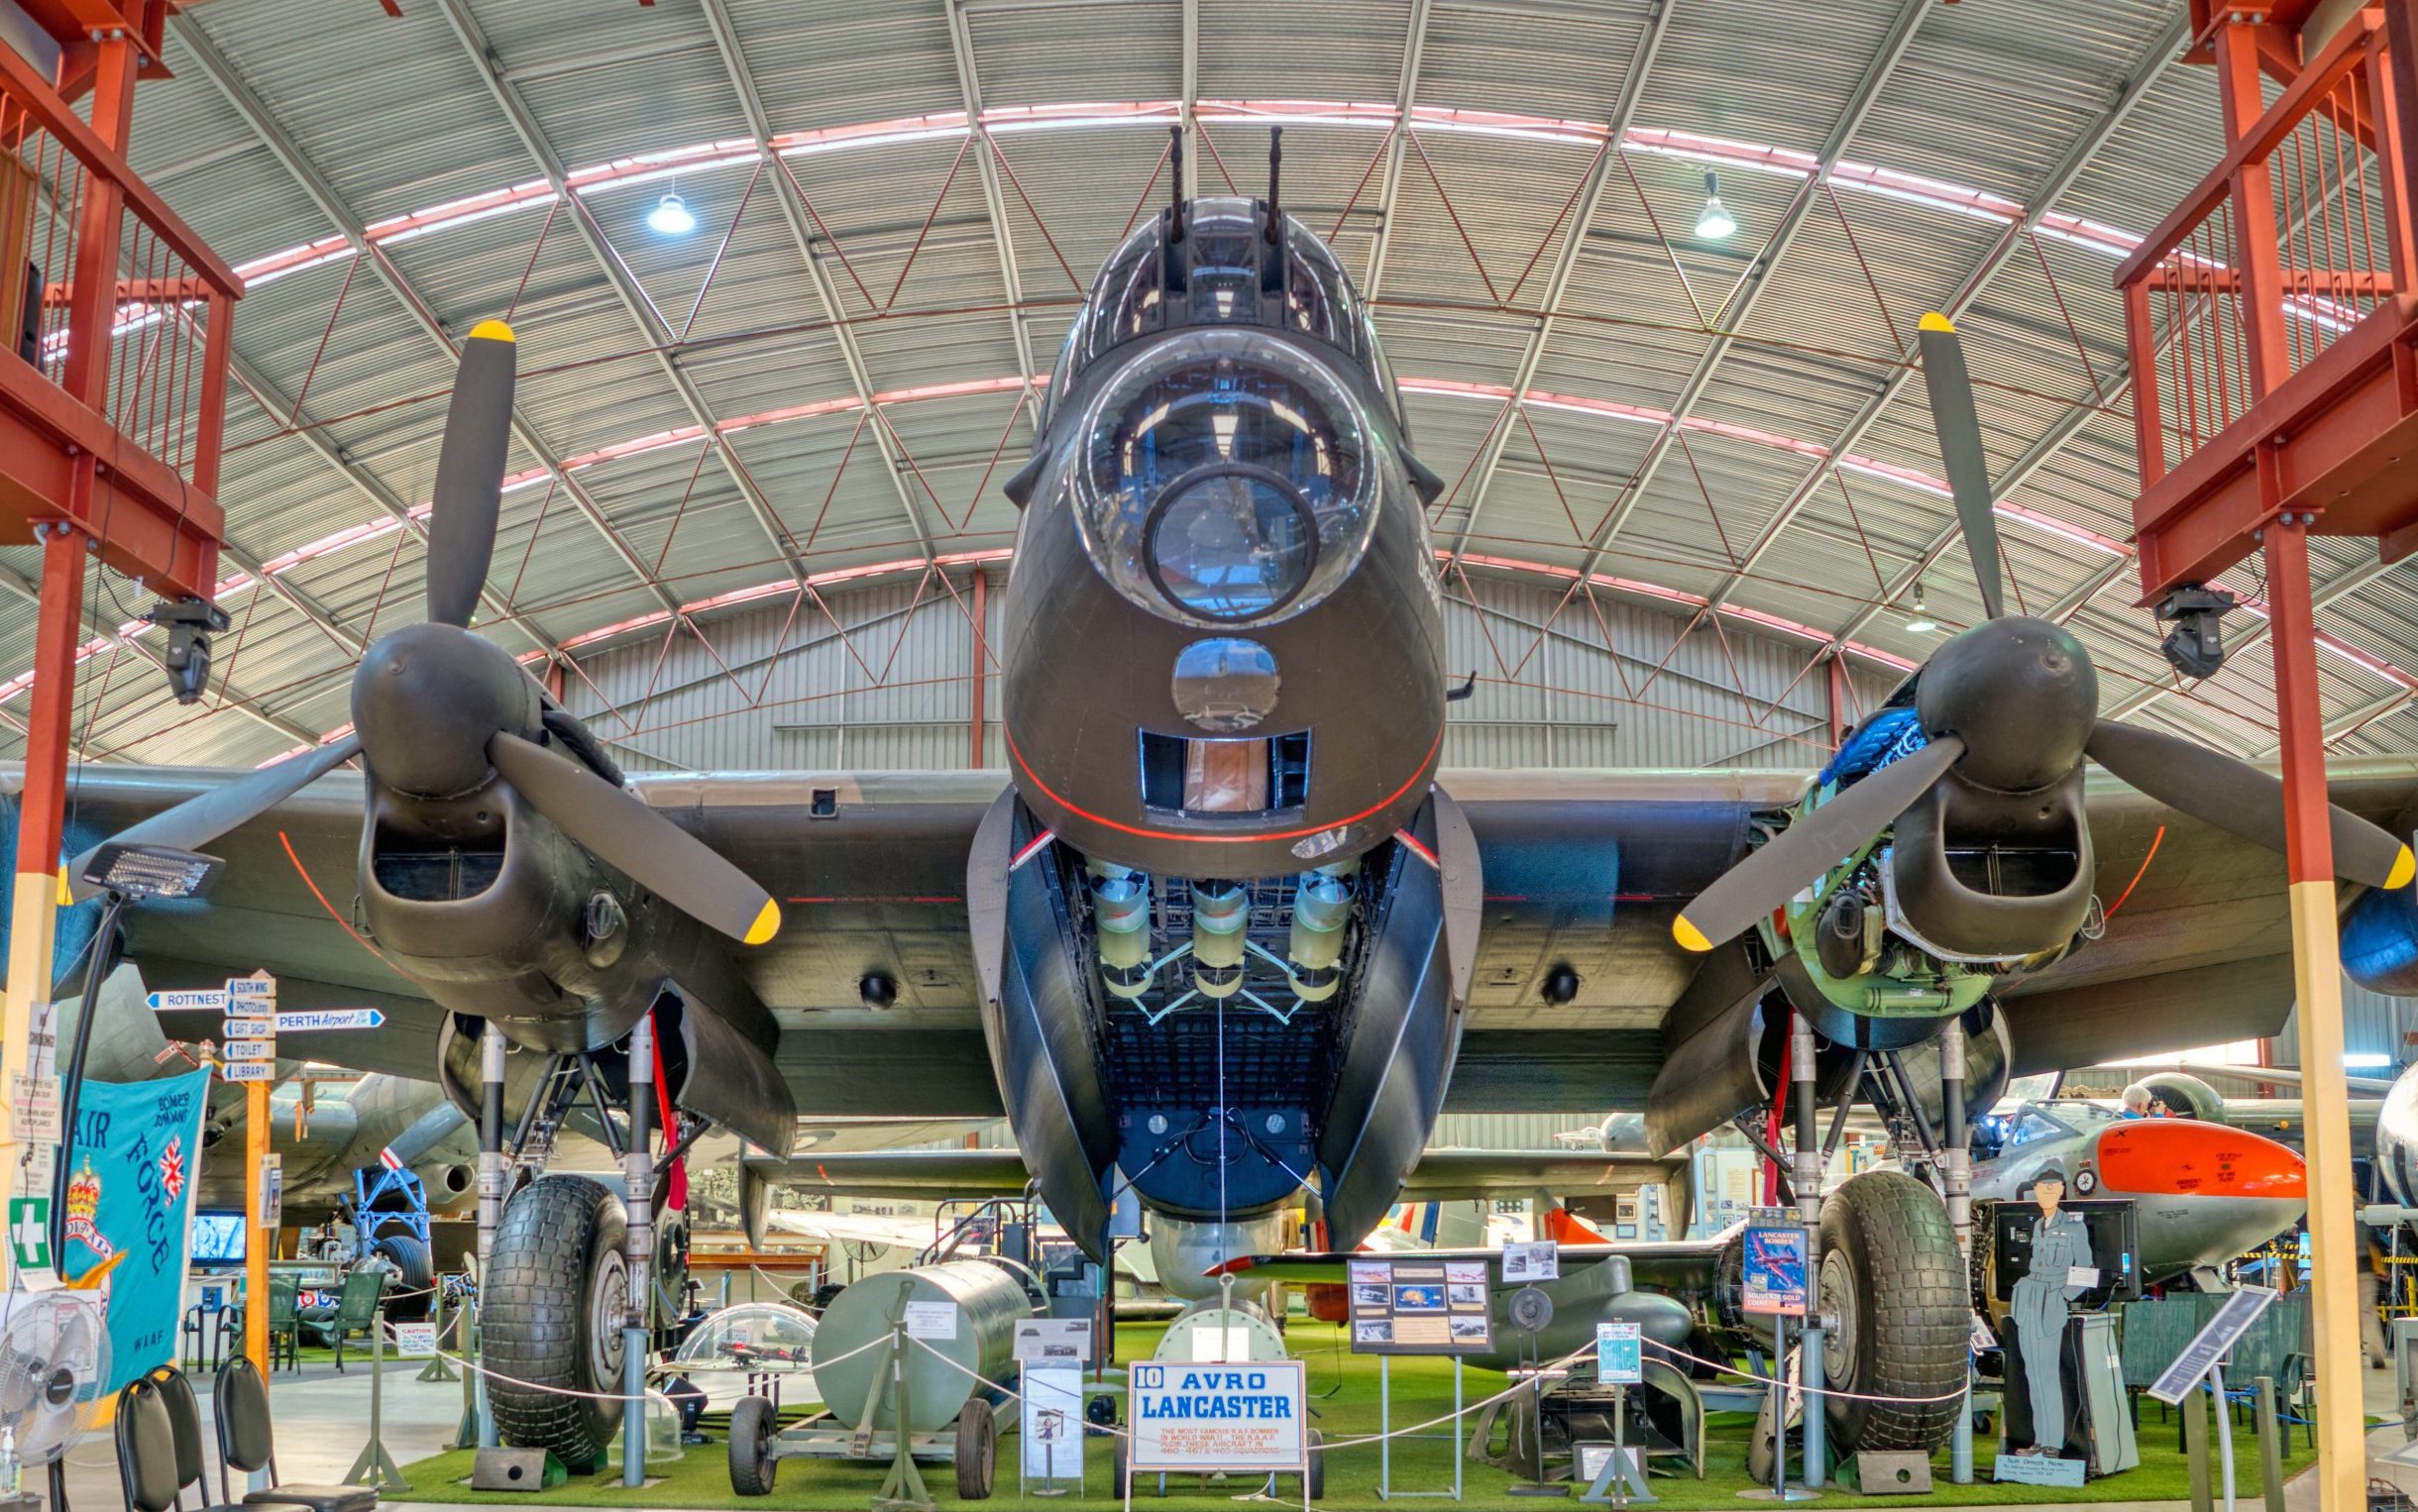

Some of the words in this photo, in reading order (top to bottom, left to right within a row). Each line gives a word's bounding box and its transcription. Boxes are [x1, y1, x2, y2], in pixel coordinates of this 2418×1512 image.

[167, 994, 226, 1007] ROTTNEST
[279, 1015, 320, 1027] PERTH
[321, 1013, 356, 1027] Airport
[250, 1024, 267, 1035] SHOP
[235, 1043, 262, 1056] TOILET
[234, 1065, 266, 1078] LIBRARY
[74, 1108, 111, 1149] AIR
[127, 1132, 169, 1274] FORCE
[134, 1330, 165, 1353] WAAF
[1137, 1367, 1162, 1388] 10
[1181, 1373, 1265, 1390] AVRO
[1142, 1396, 1291, 1418] LANCASTER
